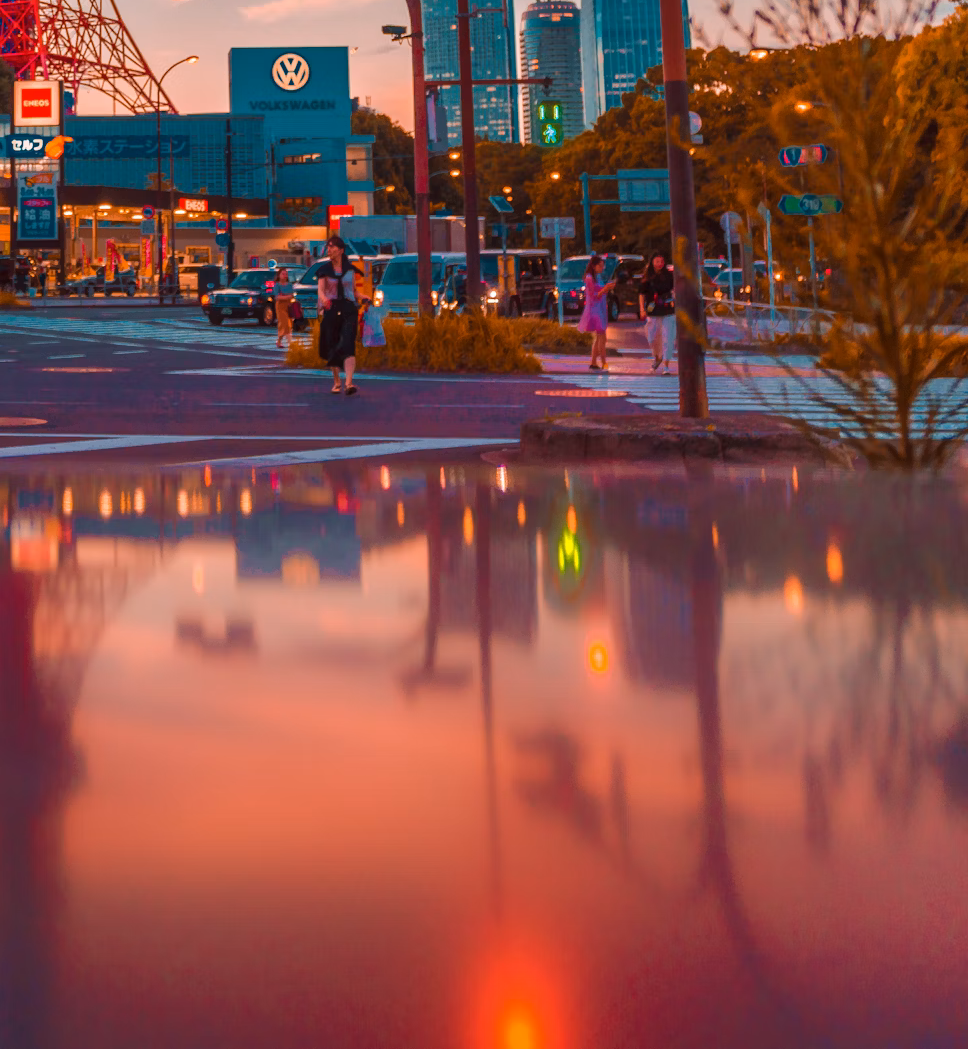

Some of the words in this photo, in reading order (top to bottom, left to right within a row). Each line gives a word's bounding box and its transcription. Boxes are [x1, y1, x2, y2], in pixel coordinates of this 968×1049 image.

[23, 99, 50, 107] ENEOS
[249, 100, 336, 110] VOLKSWAGEN
[11, 138, 44, 152] セルフ
[67, 139, 186, 155] 水素ステーション
